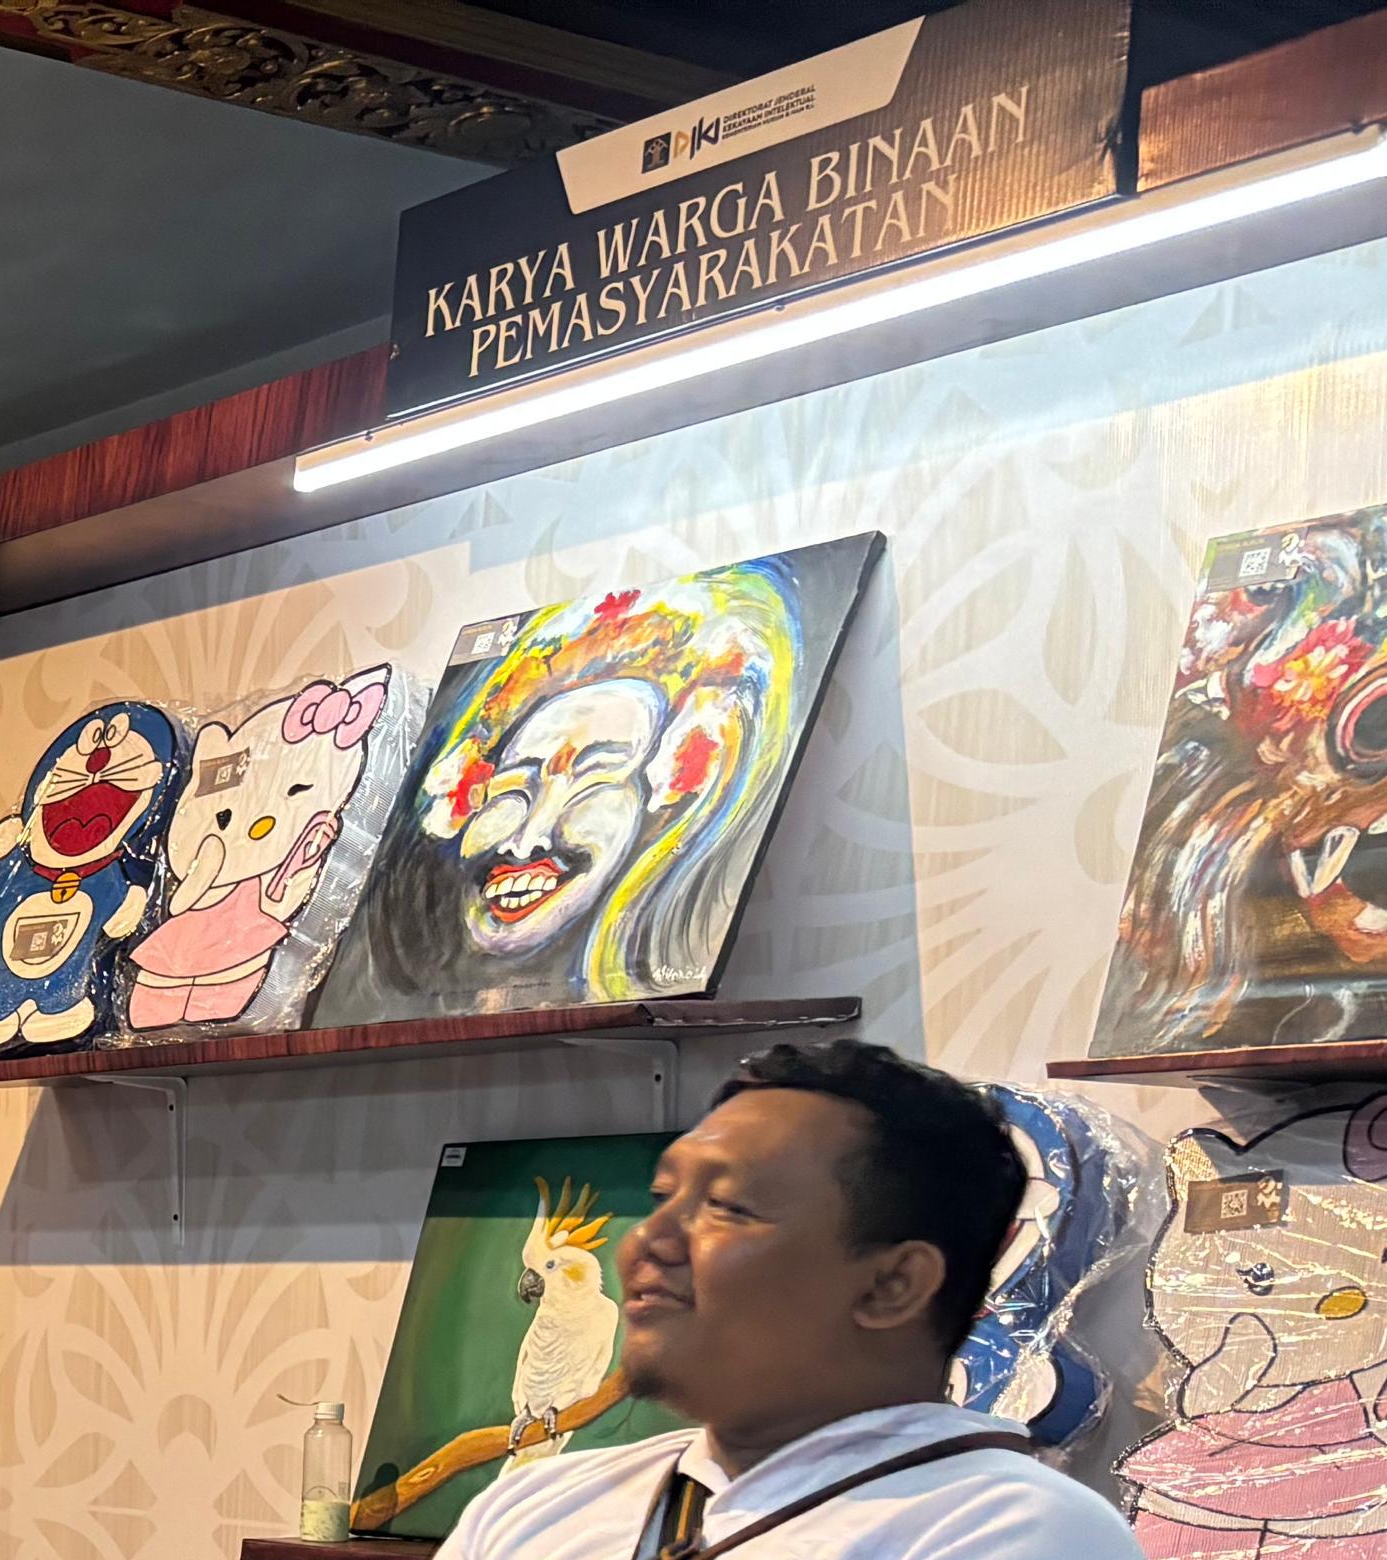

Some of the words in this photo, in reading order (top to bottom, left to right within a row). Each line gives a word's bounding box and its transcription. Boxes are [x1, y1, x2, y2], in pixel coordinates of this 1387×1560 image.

[425, 242, 576, 337] KARYA
[596, 170, 785, 280] WARGA
[805, 82, 1029, 212] BINAAN
[468, 172, 958, 378] PEMASYARAKATAN
